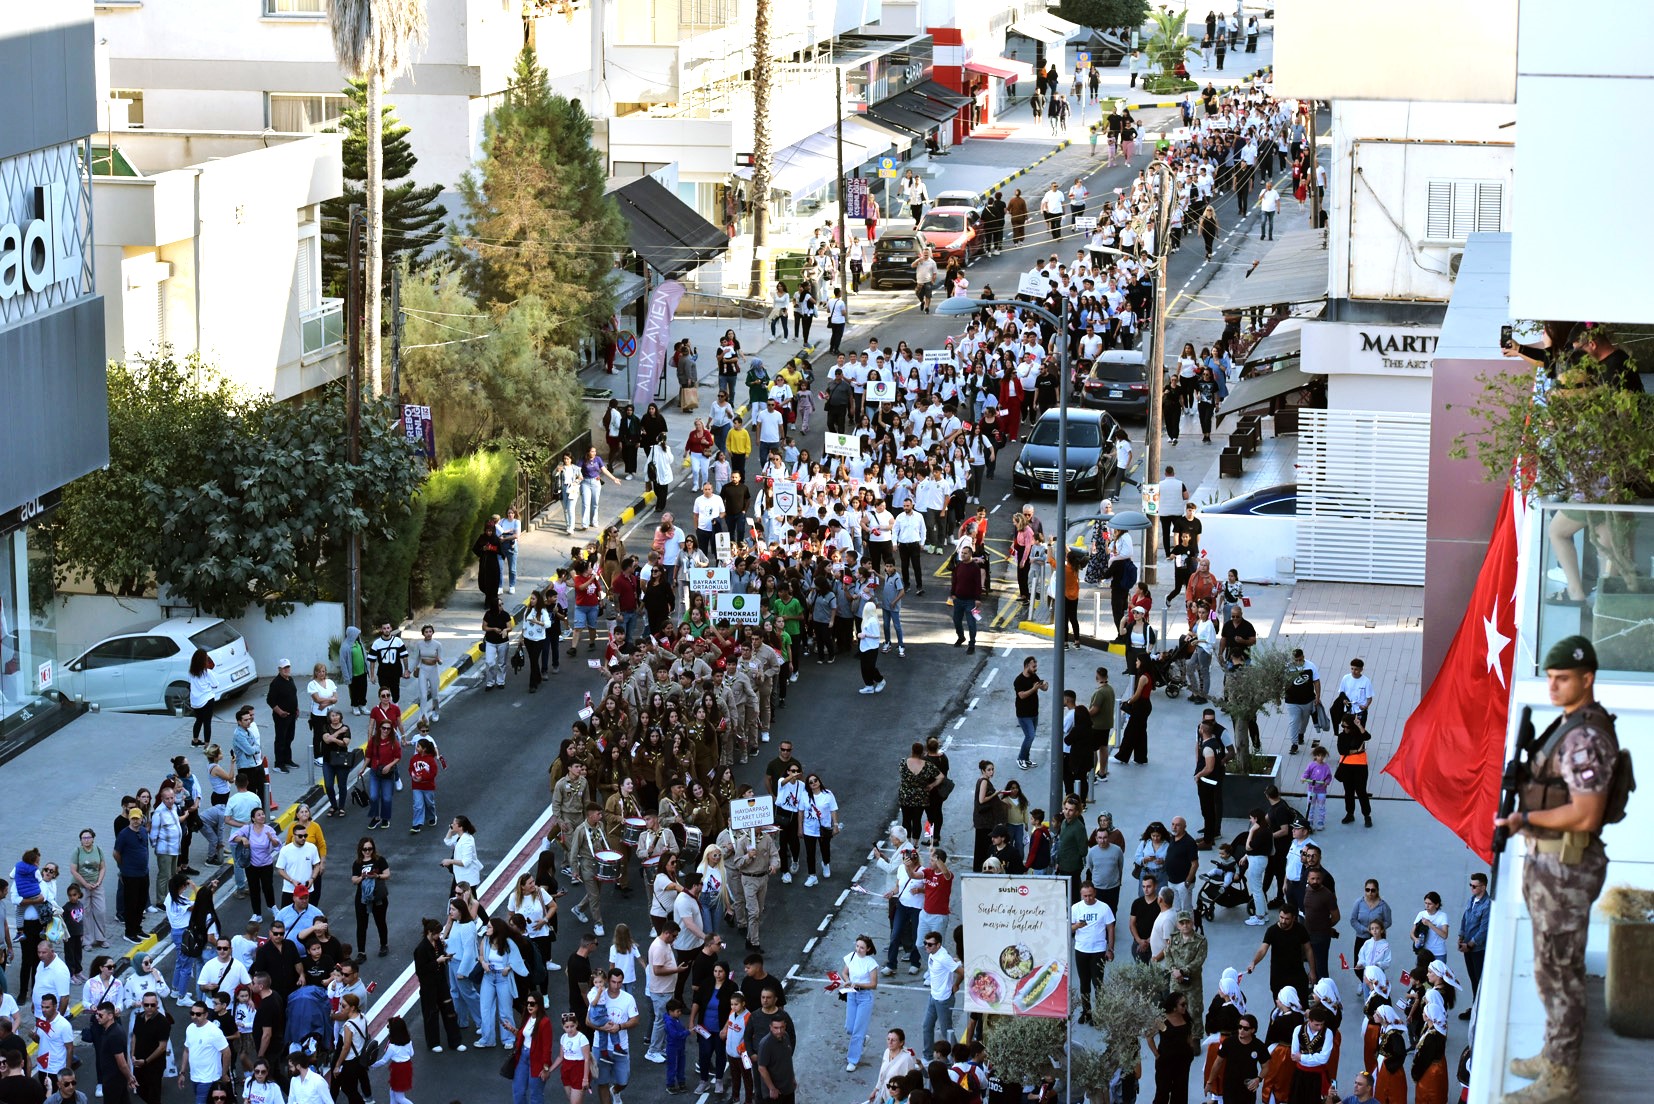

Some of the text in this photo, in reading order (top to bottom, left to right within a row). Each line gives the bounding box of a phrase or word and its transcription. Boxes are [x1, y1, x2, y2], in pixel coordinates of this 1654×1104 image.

[905, 62, 923, 84] SARAR
[1382, 358, 1403, 368] THE
[1405, 359, 1428, 368] ART
[735, 805, 769, 815] HAYDARPAŞA
[733, 813, 755, 821] TİCARET
[1083, 913, 1098, 921] LOFT
